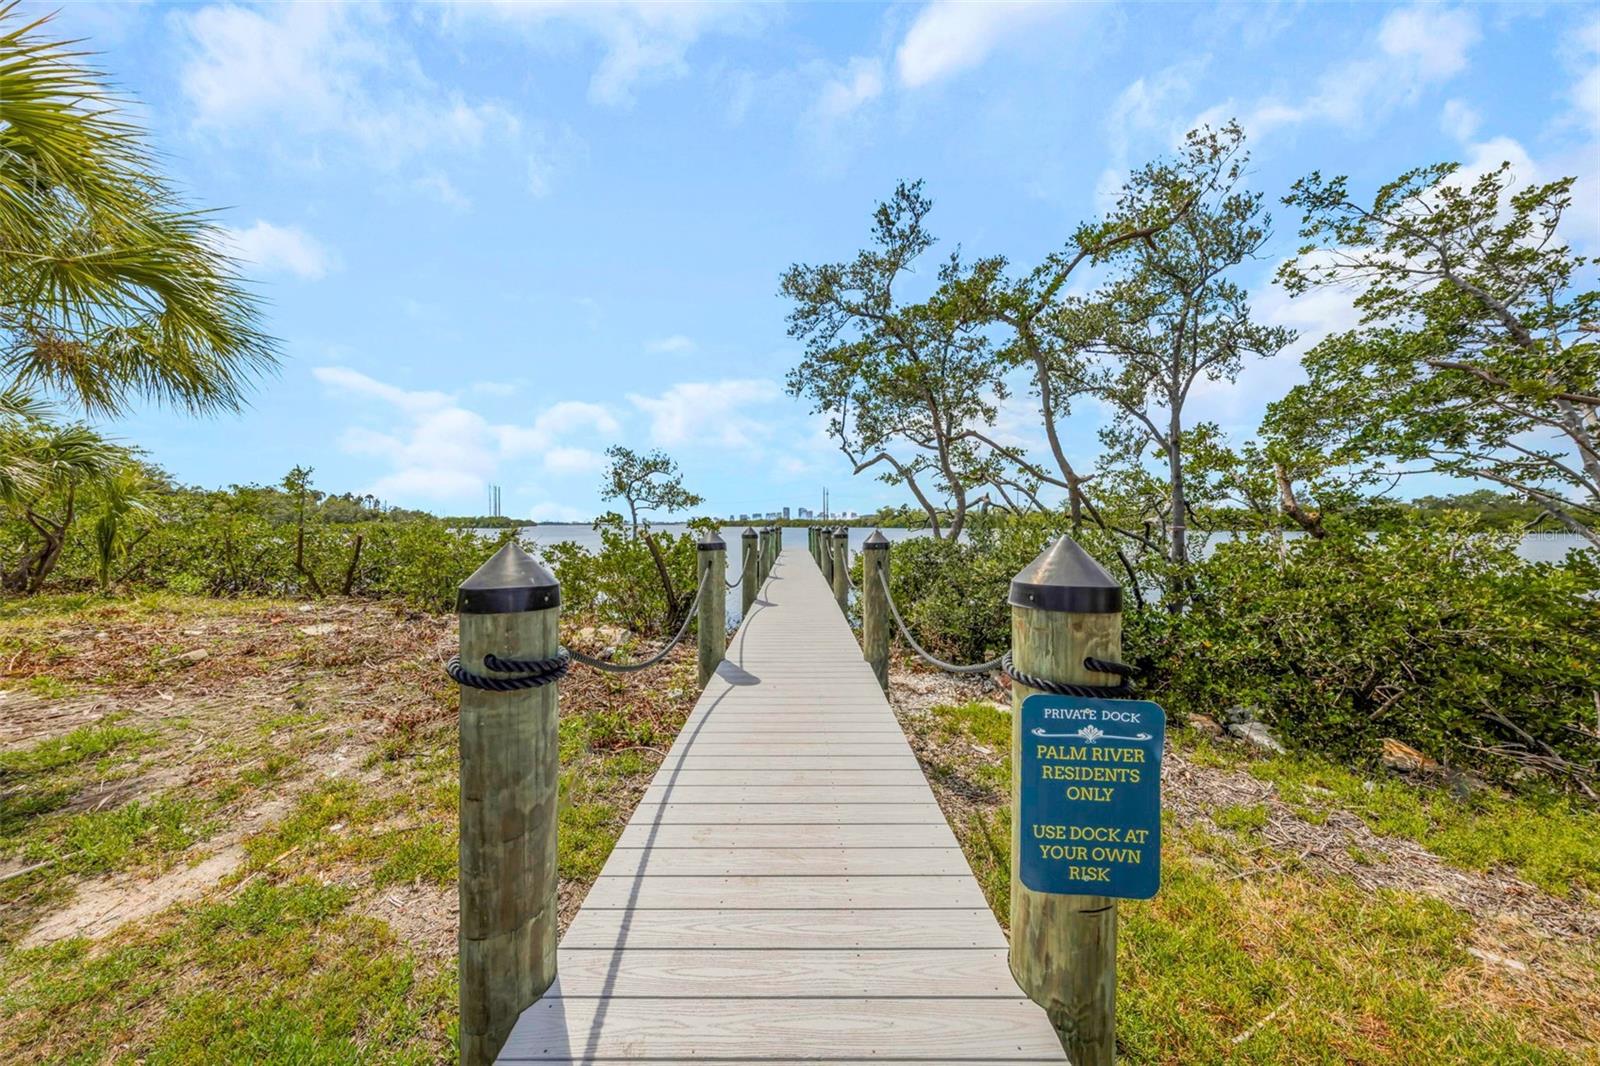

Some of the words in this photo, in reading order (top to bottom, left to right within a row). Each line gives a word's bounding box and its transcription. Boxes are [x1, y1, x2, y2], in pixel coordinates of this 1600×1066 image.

[1044, 708, 1097, 720] PRIVATE
[1101, 710, 1141, 723] DOCK
[1036, 745, 1087, 761] PALM
[1092, 747, 1145, 763] RIVER
[1042, 765, 1140, 783] RESIDENTS
[1066, 786, 1114, 802] ONLY
[1033, 825, 1065, 839] USE
[1069, 826, 1121, 842] DOCK
[1124, 829, 1149, 844] AT
[1039, 845, 1088, 861] YOUR
[1092, 847, 1141, 864] OWN
[1069, 866, 1110, 881] RISK
